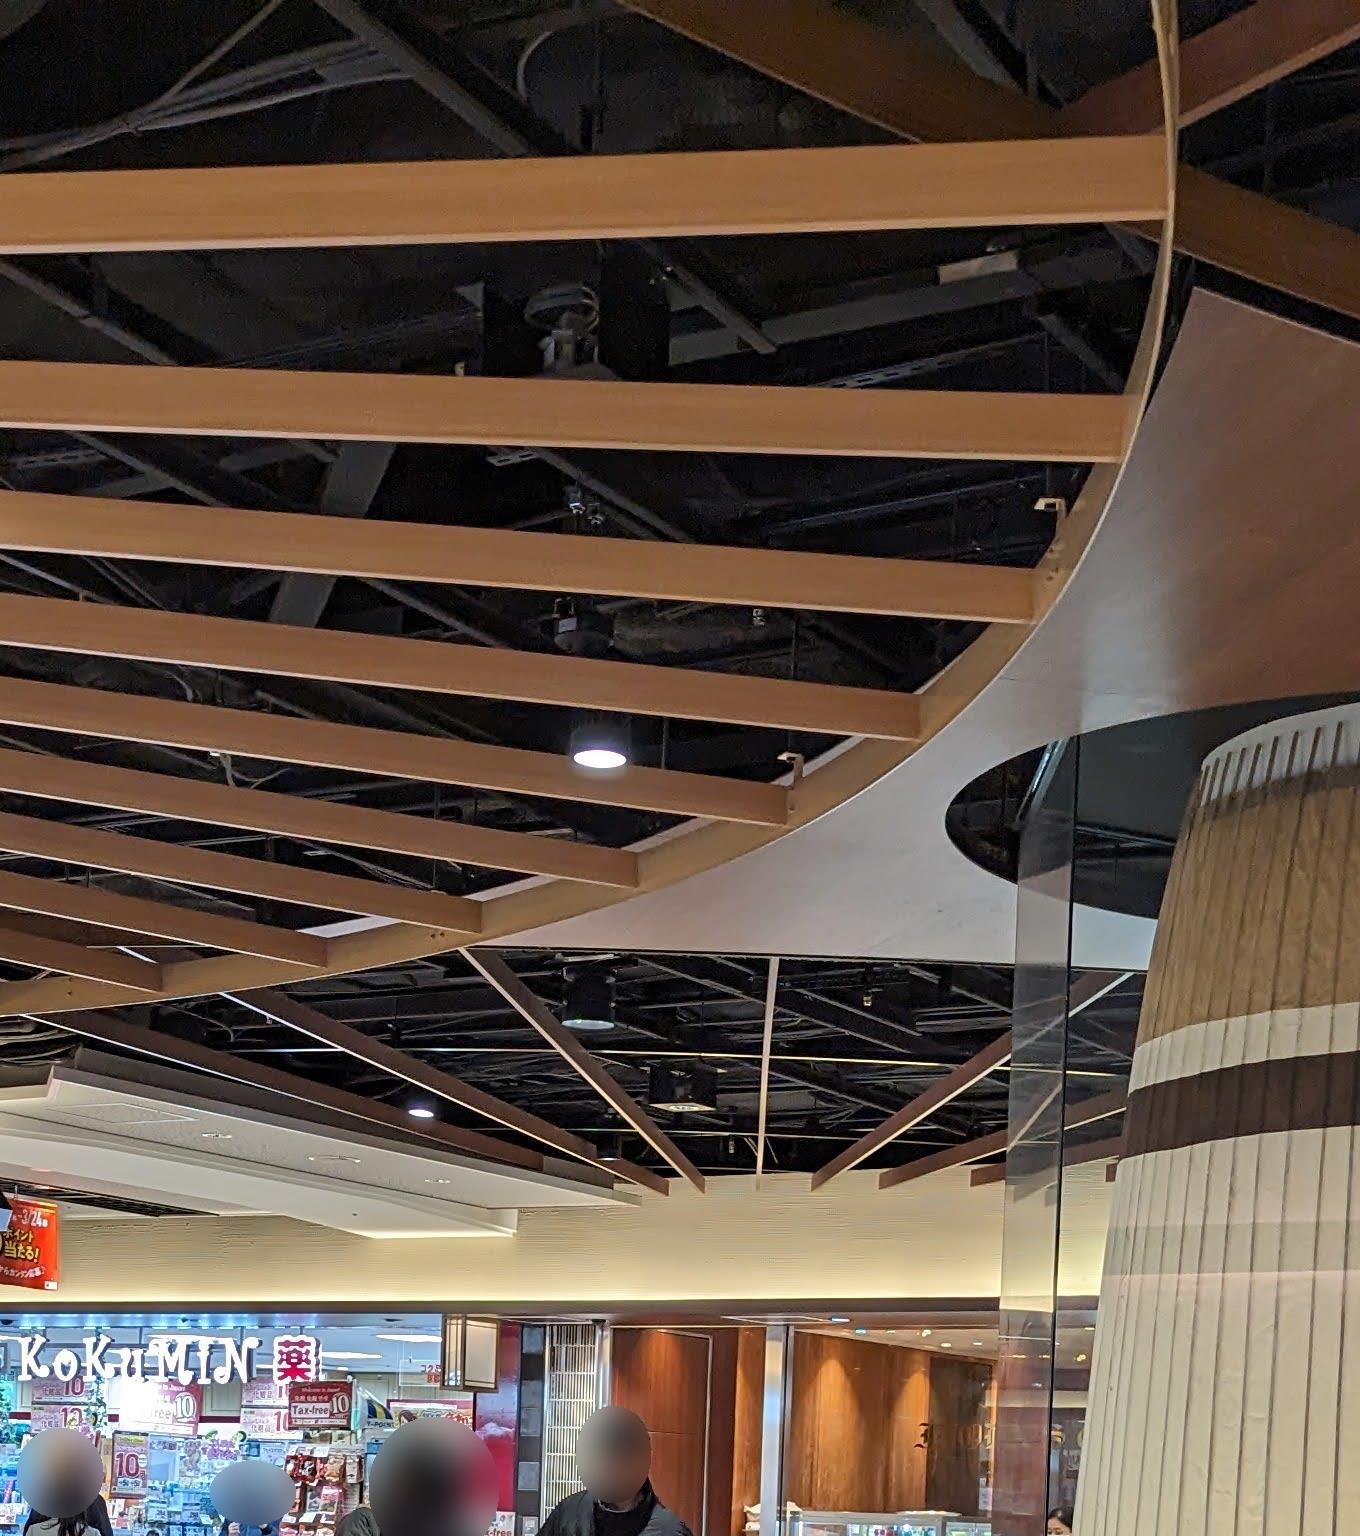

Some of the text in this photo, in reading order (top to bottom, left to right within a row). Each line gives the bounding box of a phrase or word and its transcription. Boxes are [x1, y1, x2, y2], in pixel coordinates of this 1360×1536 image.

[277, 1339, 312, 1381] 薬
[292, 1404, 329, 1415] Tax-free
[115, 1452, 140, 1478] 10
